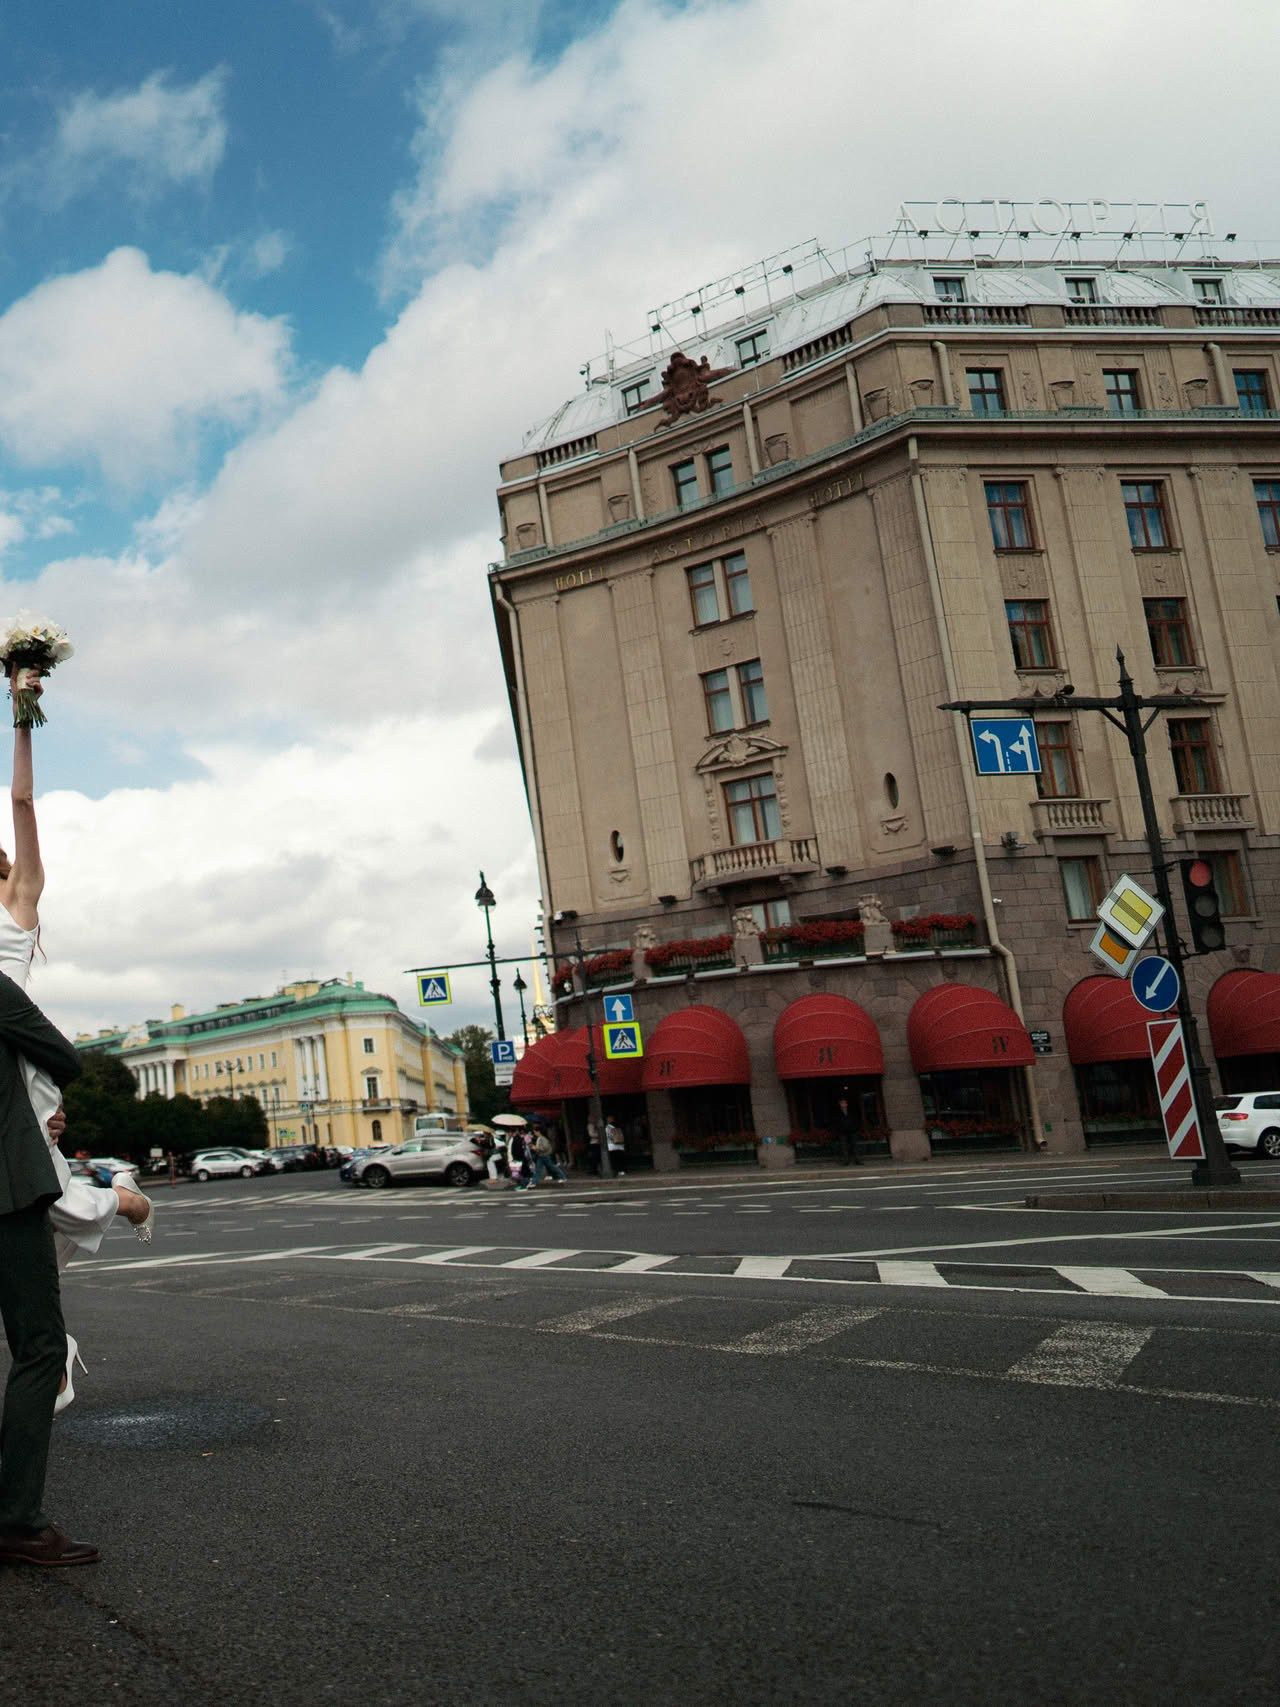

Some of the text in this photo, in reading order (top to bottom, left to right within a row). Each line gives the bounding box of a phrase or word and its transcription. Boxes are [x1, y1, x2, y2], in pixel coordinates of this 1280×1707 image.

[891, 198, 1216, 236] АСТОРИЯ
[651, 513, 767, 563] ASTORIA
[498, 1043, 510, 1061] P
